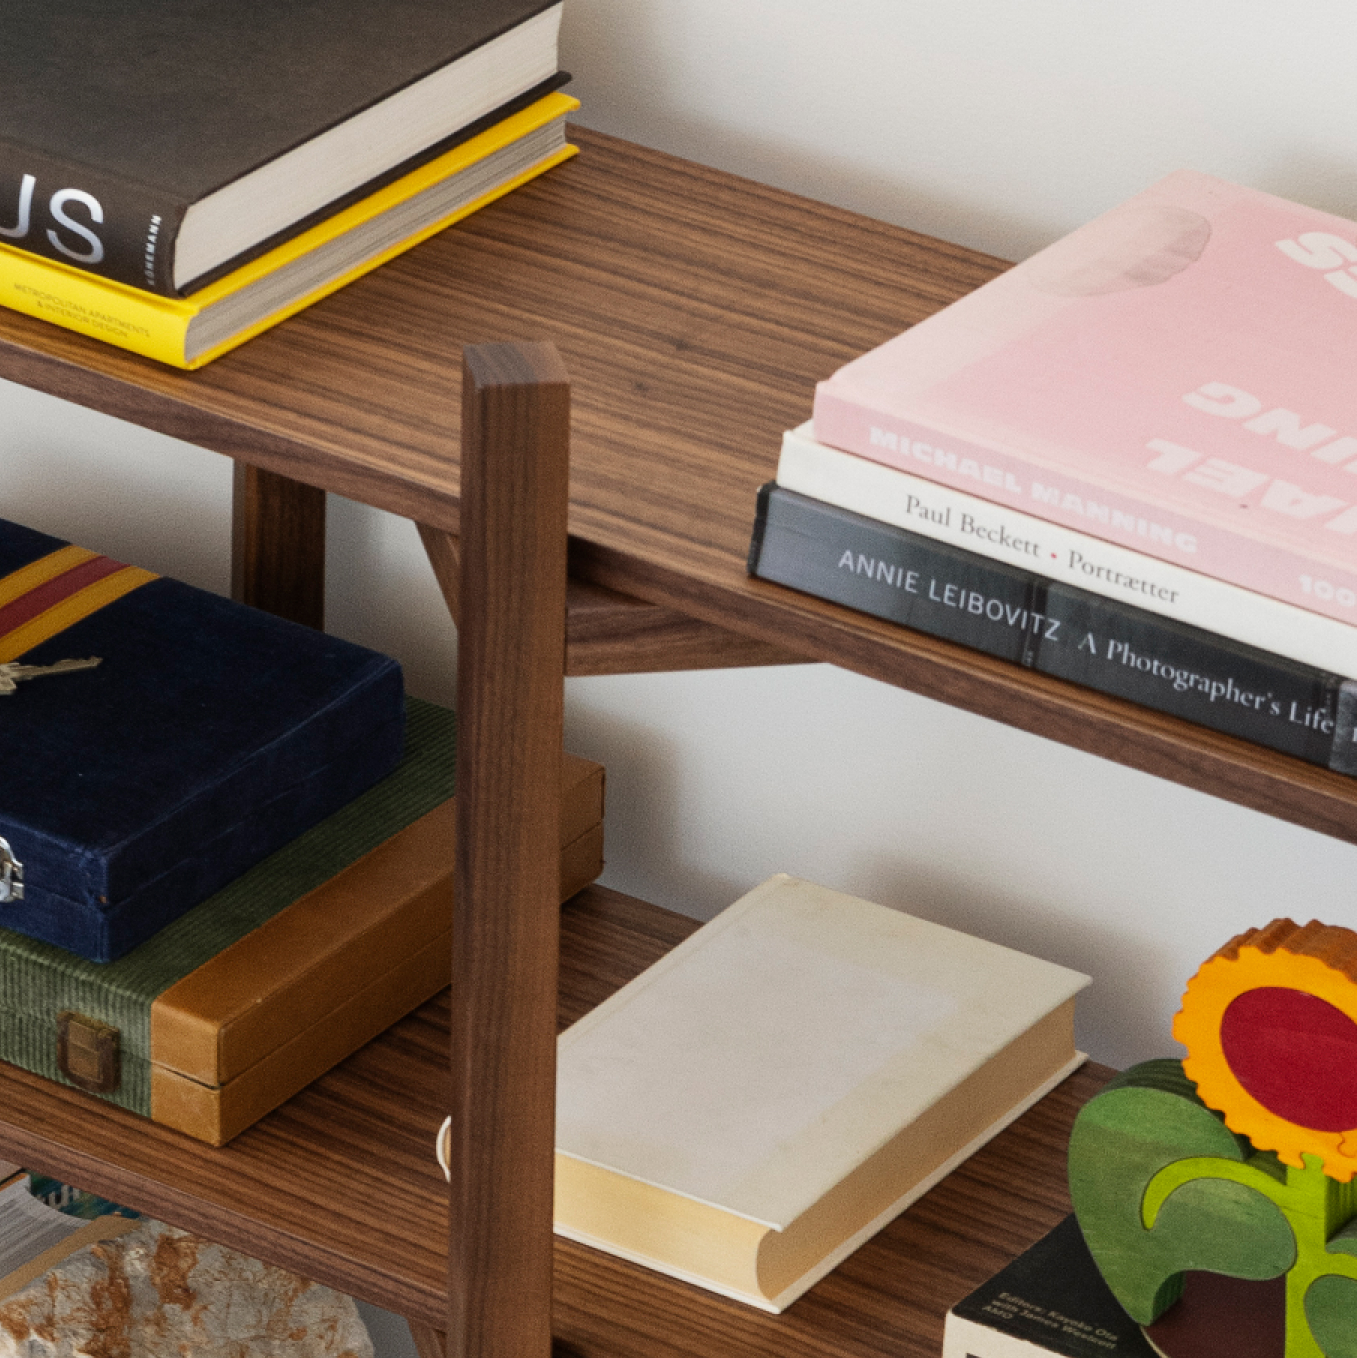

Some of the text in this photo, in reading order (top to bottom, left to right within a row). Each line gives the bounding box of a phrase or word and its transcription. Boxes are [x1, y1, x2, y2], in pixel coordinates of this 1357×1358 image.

[868, 426, 1024, 506] MICHAEL
[1029, 472, 1199, 555] MANNING
[1299, 574, 1356, 609] 100
[905, 493, 1180, 604] Paul Beckett Portrætter
[837, 547, 920, 594] ANNIE
[928, 577, 1062, 642] LEIBOVITZ
[1076, 630, 1098, 656] A
[1105, 637, 1283, 718] Photographer's
[1288, 700, 1336, 736] Life
